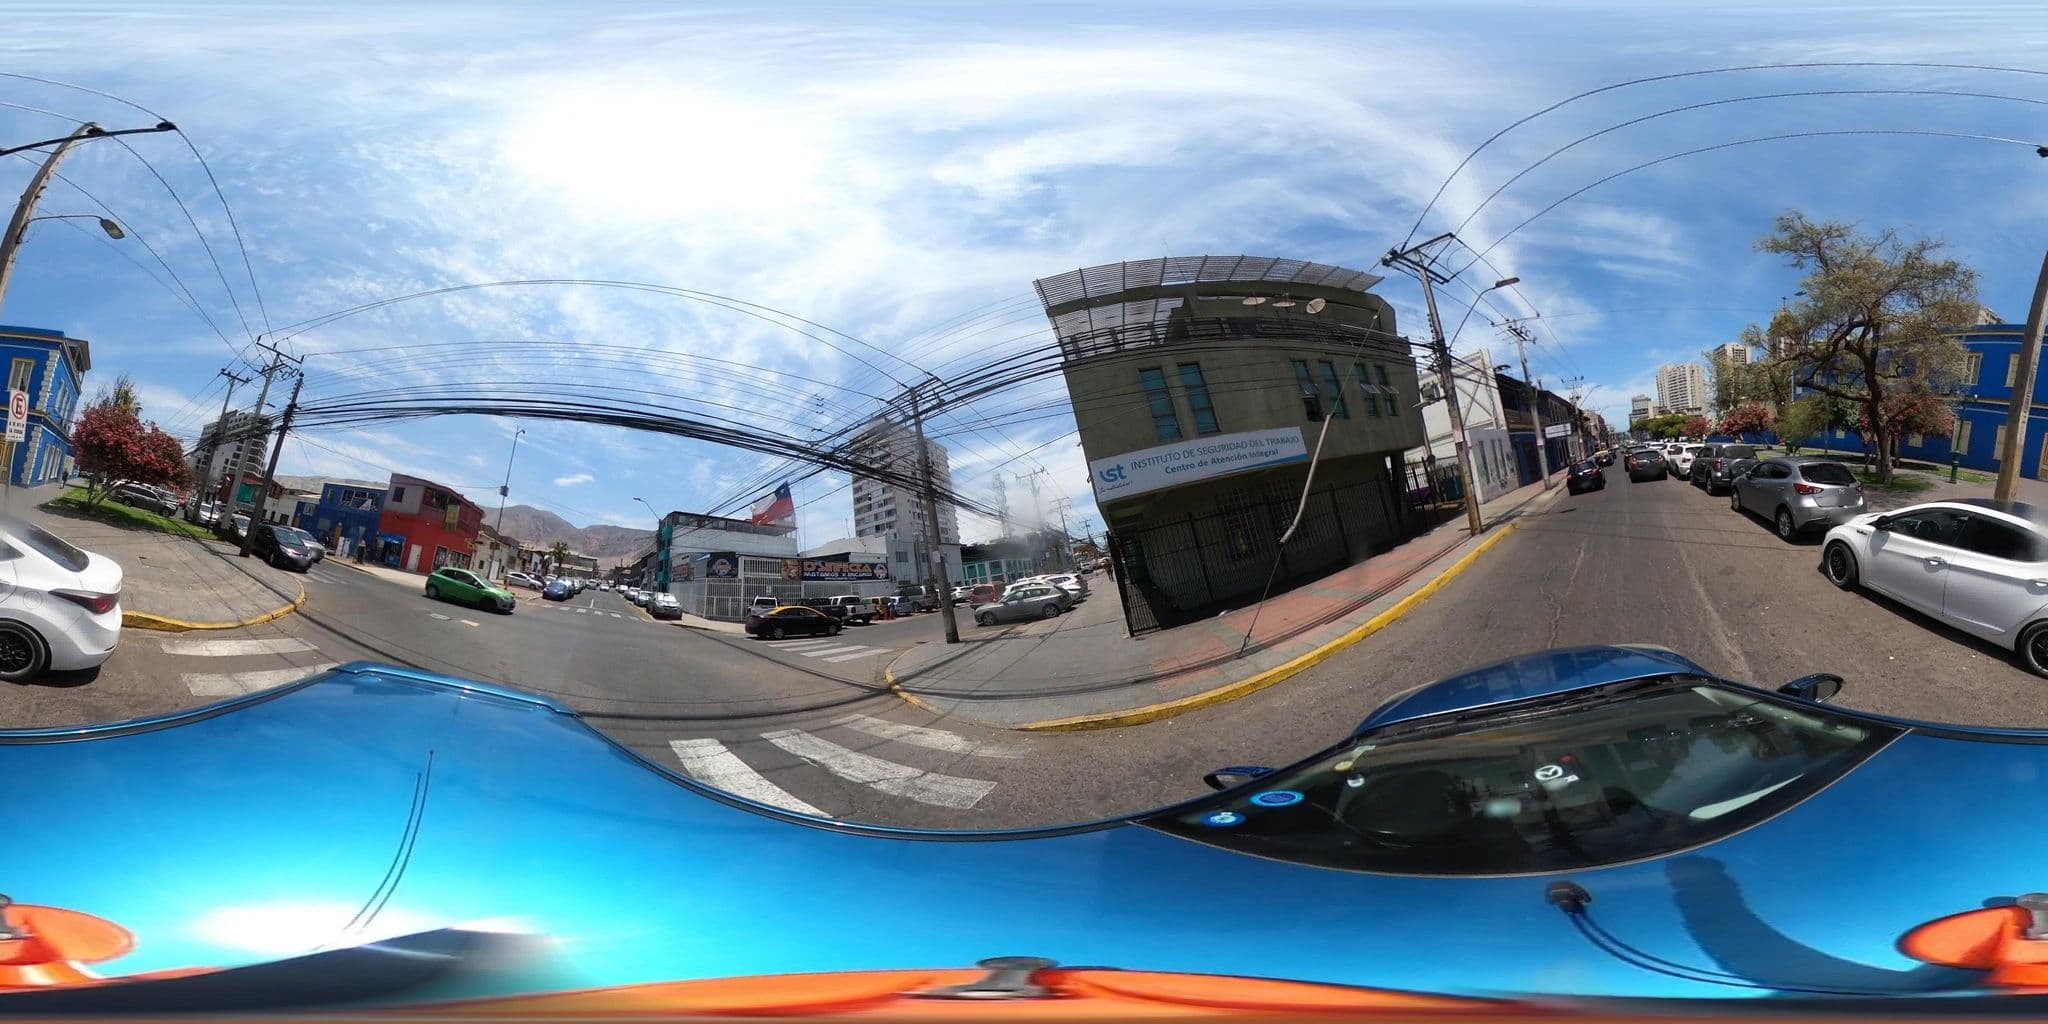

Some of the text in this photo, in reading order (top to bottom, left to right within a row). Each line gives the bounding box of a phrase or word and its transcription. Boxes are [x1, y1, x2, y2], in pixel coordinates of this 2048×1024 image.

[1130, 435, 1299, 470] INSTITUTO DE SEGURIDAD DEL TRABAJO
[1165, 448, 1279, 474] Centro de Atención Integral
[1100, 463, 1127, 482] ist
